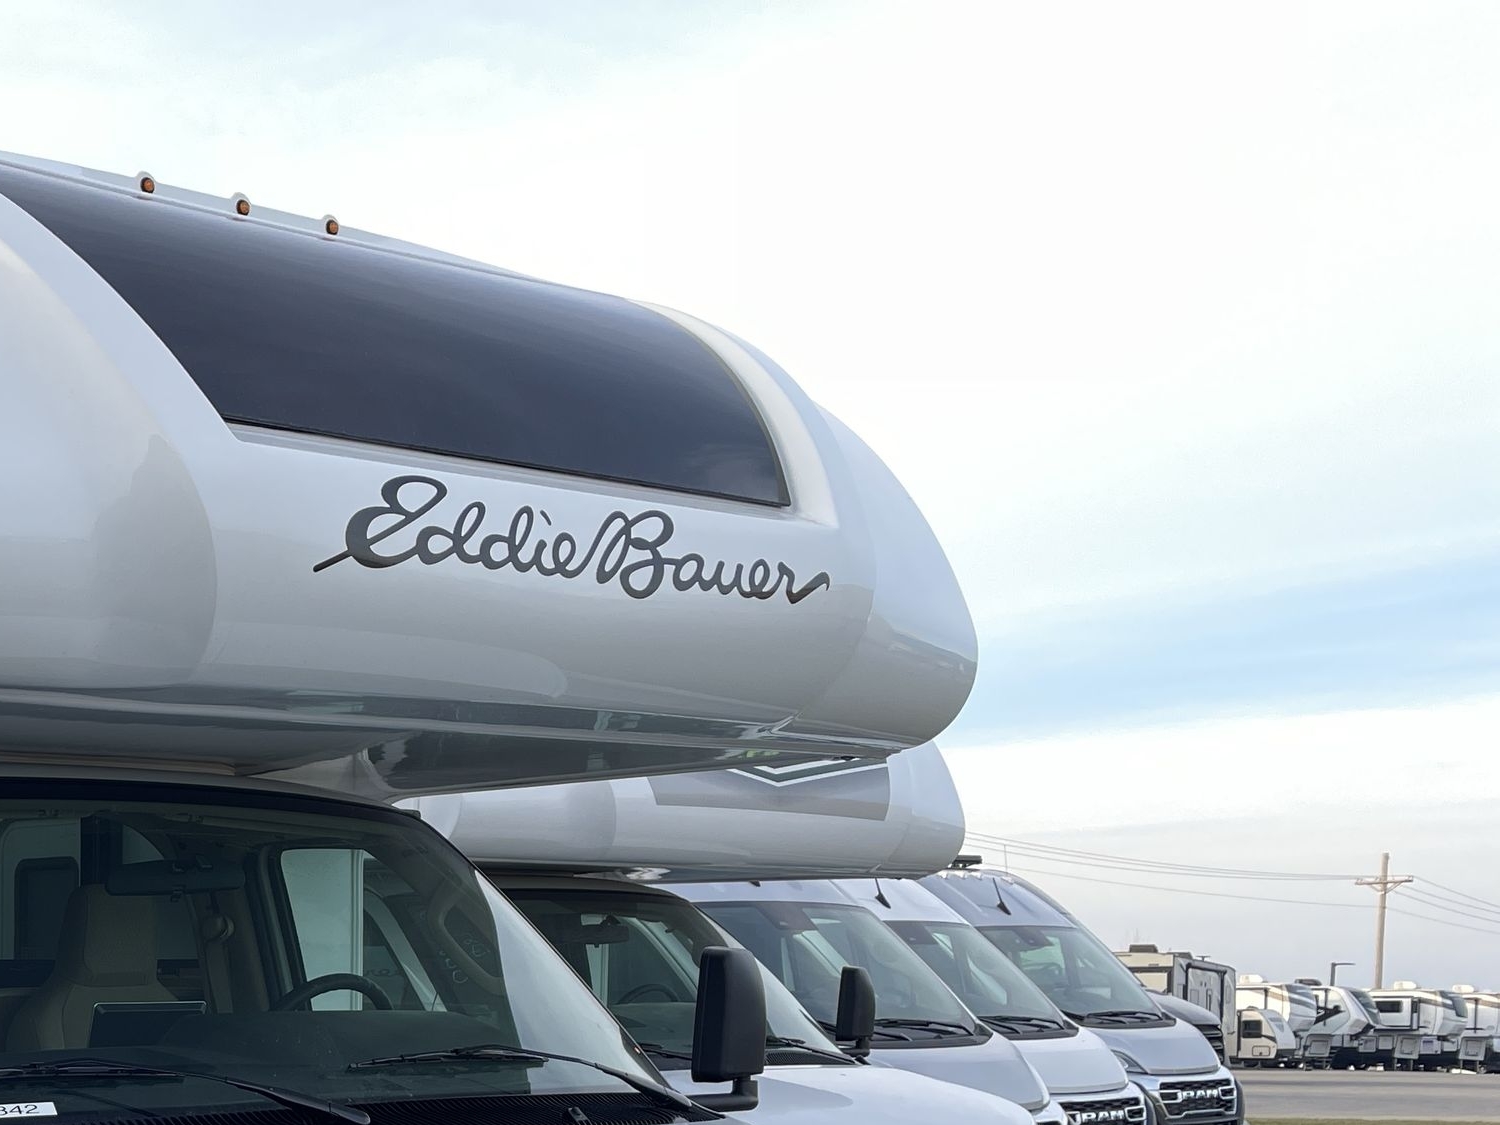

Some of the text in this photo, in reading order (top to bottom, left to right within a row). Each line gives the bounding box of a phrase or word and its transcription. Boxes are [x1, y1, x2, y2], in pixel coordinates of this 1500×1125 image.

[313, 474, 831, 604] Eddie Bauer
[1182, 1088, 1219, 1100] RAM
[1081, 1110, 1125, 1124] RAM
